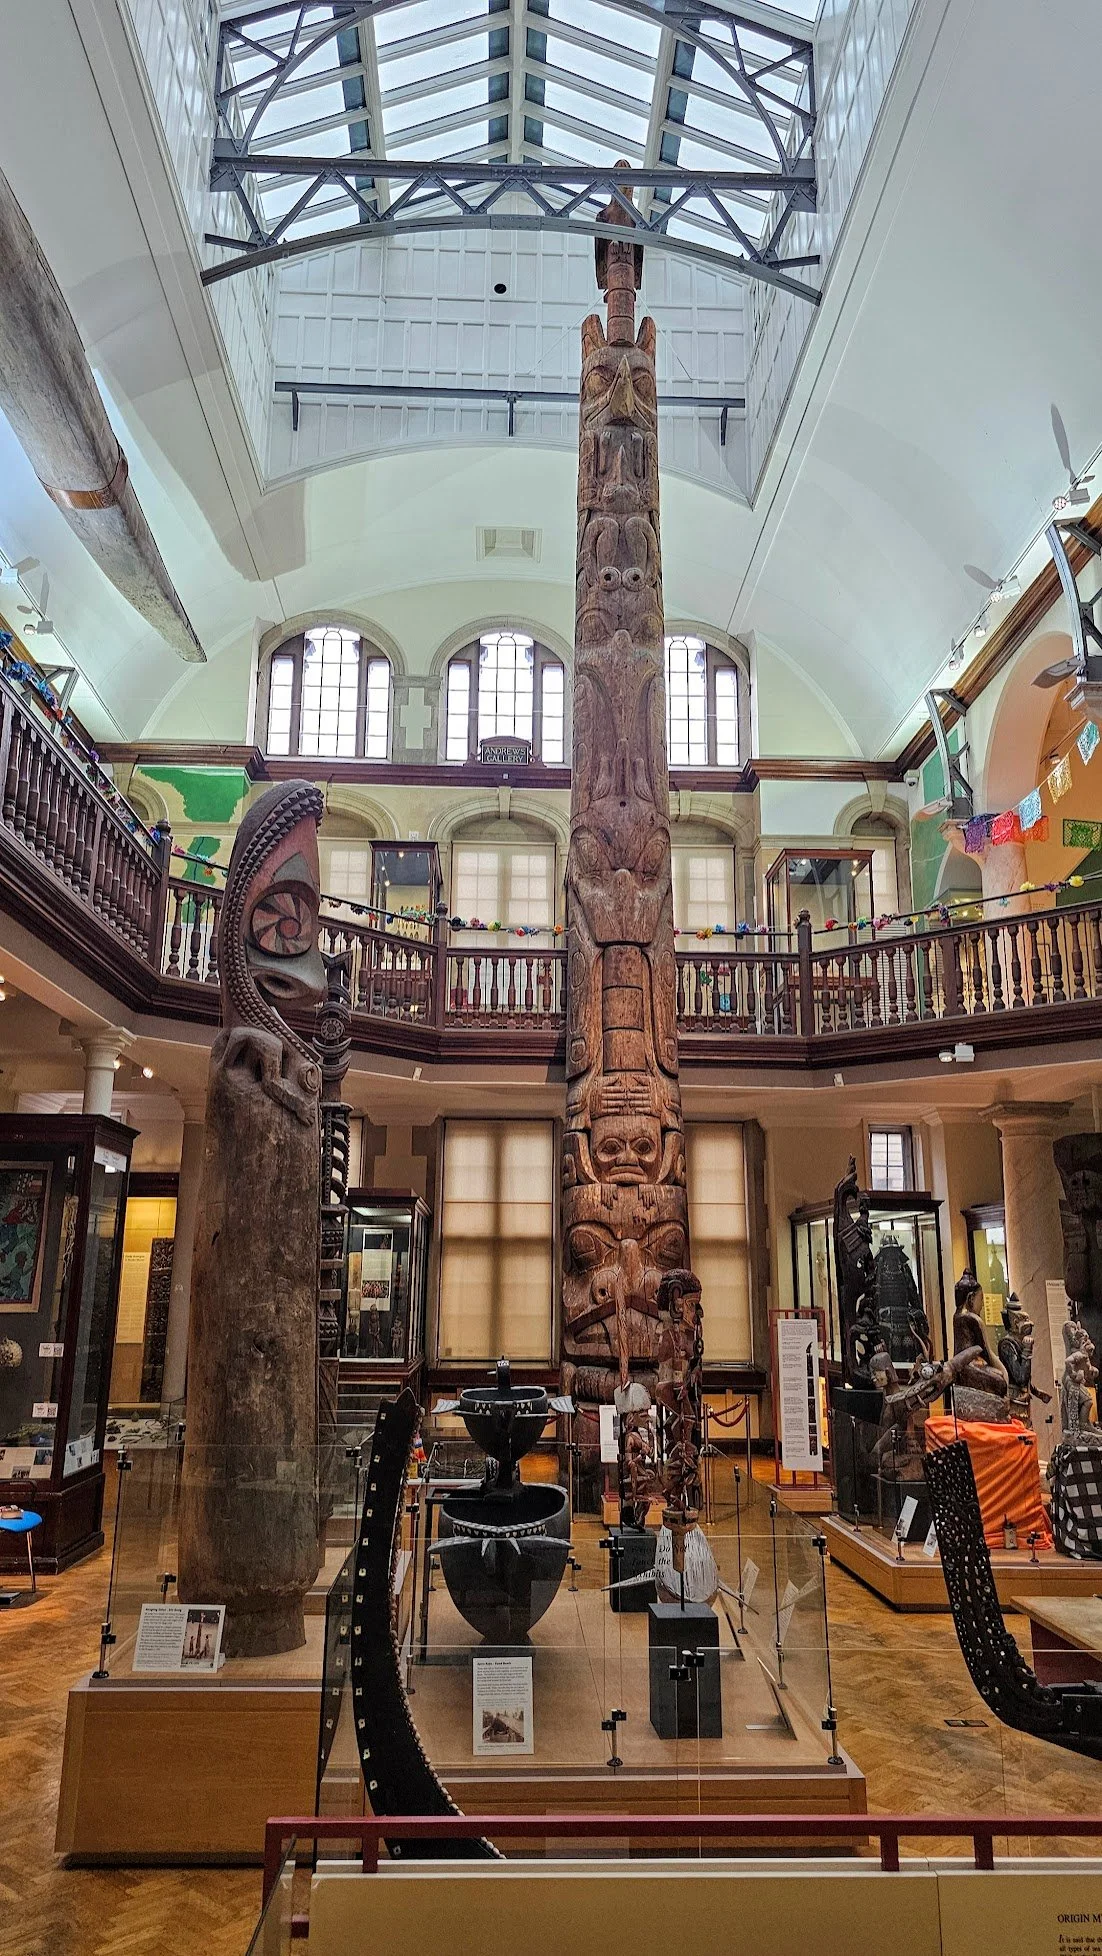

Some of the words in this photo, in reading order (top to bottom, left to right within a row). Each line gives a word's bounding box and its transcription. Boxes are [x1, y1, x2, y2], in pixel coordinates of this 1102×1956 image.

[485, 747, 526, 755] ANDREWS
[659, 1558, 671, 1566] the
[1057, 1914, 1090, 1923] ORIGIN
